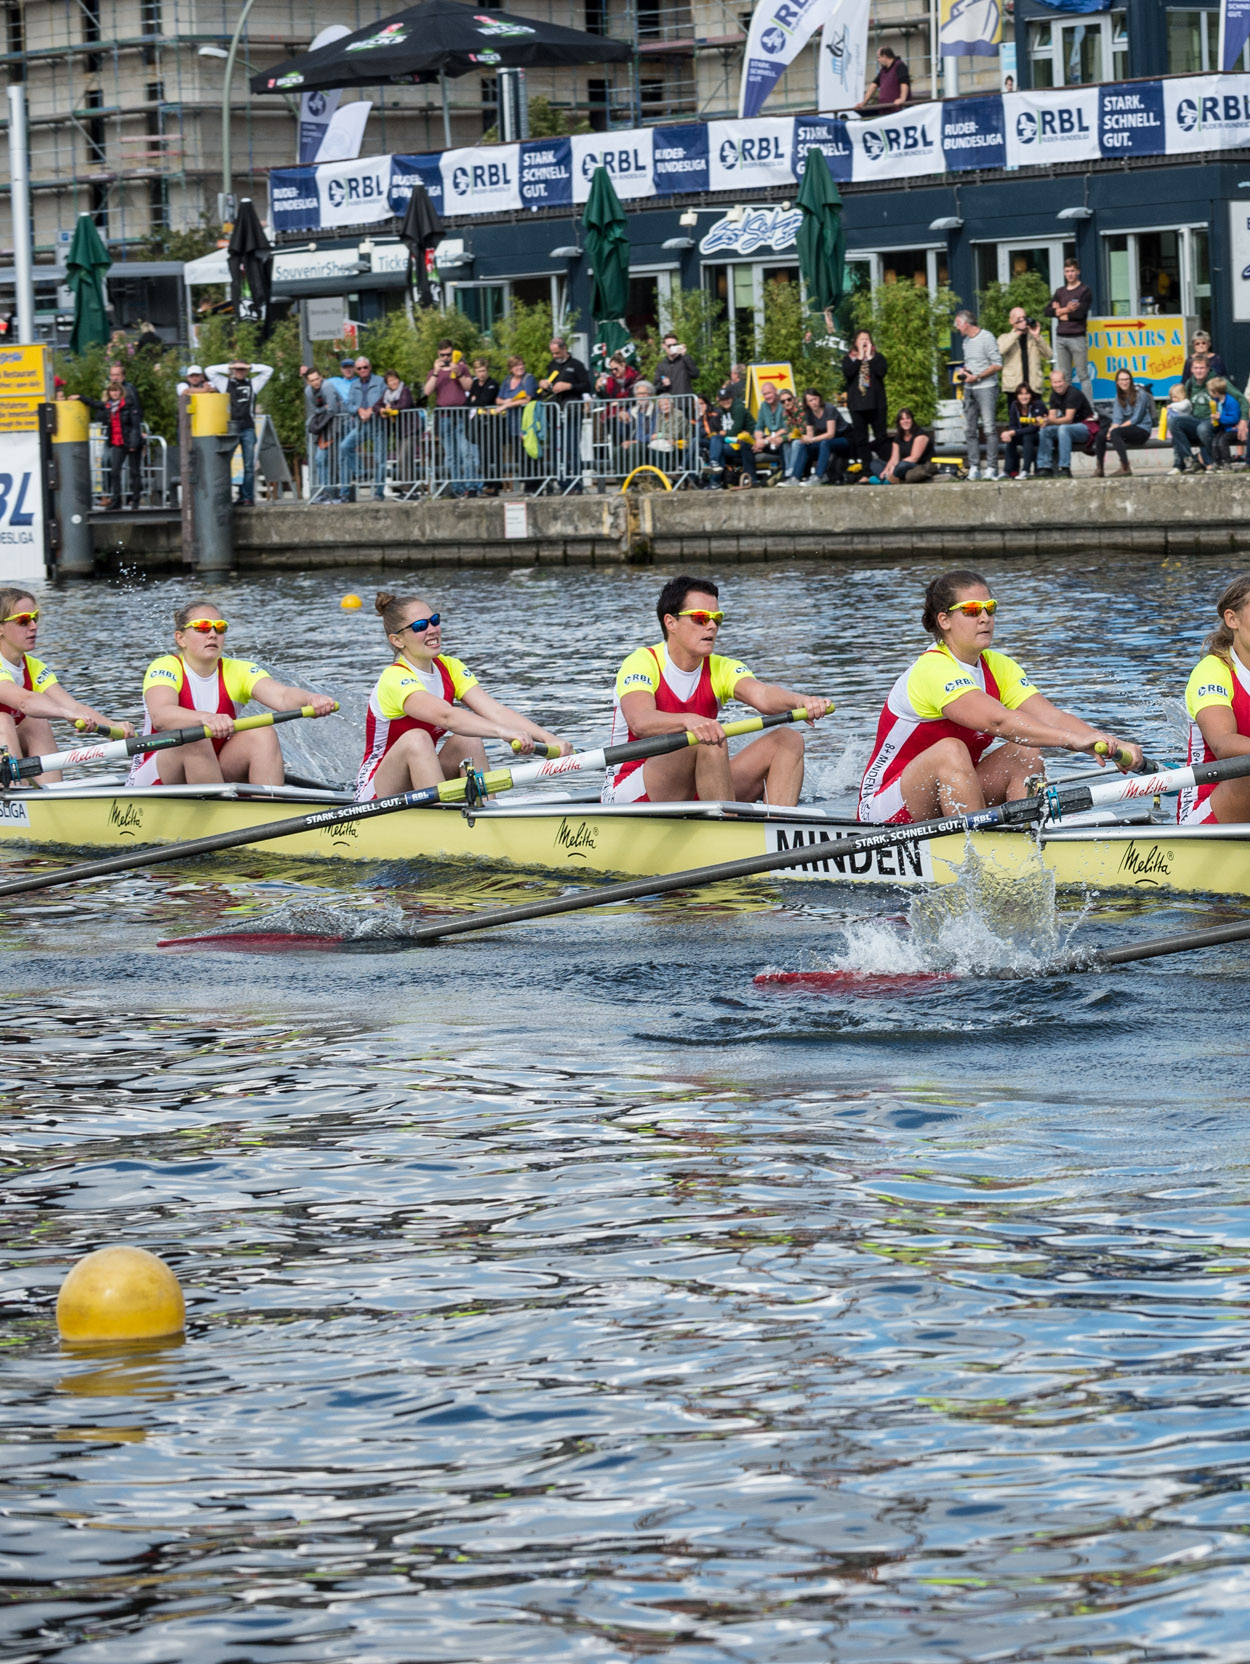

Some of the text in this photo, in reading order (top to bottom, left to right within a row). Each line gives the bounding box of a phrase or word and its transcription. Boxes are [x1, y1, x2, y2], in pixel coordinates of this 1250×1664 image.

[1103, 95, 1145, 112] STARK.
[944, 122, 979, 136] RUDER-
[1041, 108, 1090, 135] RBL
[1103, 112, 1160, 130] SCHNELL.
[797, 126, 833, 140] STARK.
[884, 124, 934, 151] RBL
[943, 134, 1003, 150] BUNDESLIGA
[1103, 132, 1132, 148] GUT.
[654, 147, 686, 160] RUDER-
[741, 136, 785, 161] RBL
[523, 150, 557, 166] STARK.
[603, 148, 647, 174] RBL
[656, 159, 707, 174] BUNDESLIGA
[473, 163, 512, 188] RBL
[522, 165, 570, 183] SCHNELL.
[272, 187, 300, 199] RUDER-
[348, 174, 384, 199] RBL
[522, 183, 548, 198] GUT.
[273, 198, 319, 211] BUNDESLIGA
[1171, 329, 1182, 346] &
[1106, 354, 1184, 376] BOAT Tickets
[158, 669, 177, 682] RBL
[632, 674, 653, 686] RBL
[1207, 684, 1228, 697] RBL
[64, 745, 106, 765] Melitta
[536, 756, 583, 779] Melitta
[1120, 776, 1169, 801] Melitta
[108, 799, 142, 828] Melitta
[306, 791, 429, 825] STARK. SCHNELL. GUT. RBL
[553, 817, 597, 849] Melitta
[855, 813, 992, 849] STARK. SCHNELL. GUT. RBL
[776, 829, 924, 877] MINDEN
[1118, 840, 1172, 876] Melitta
